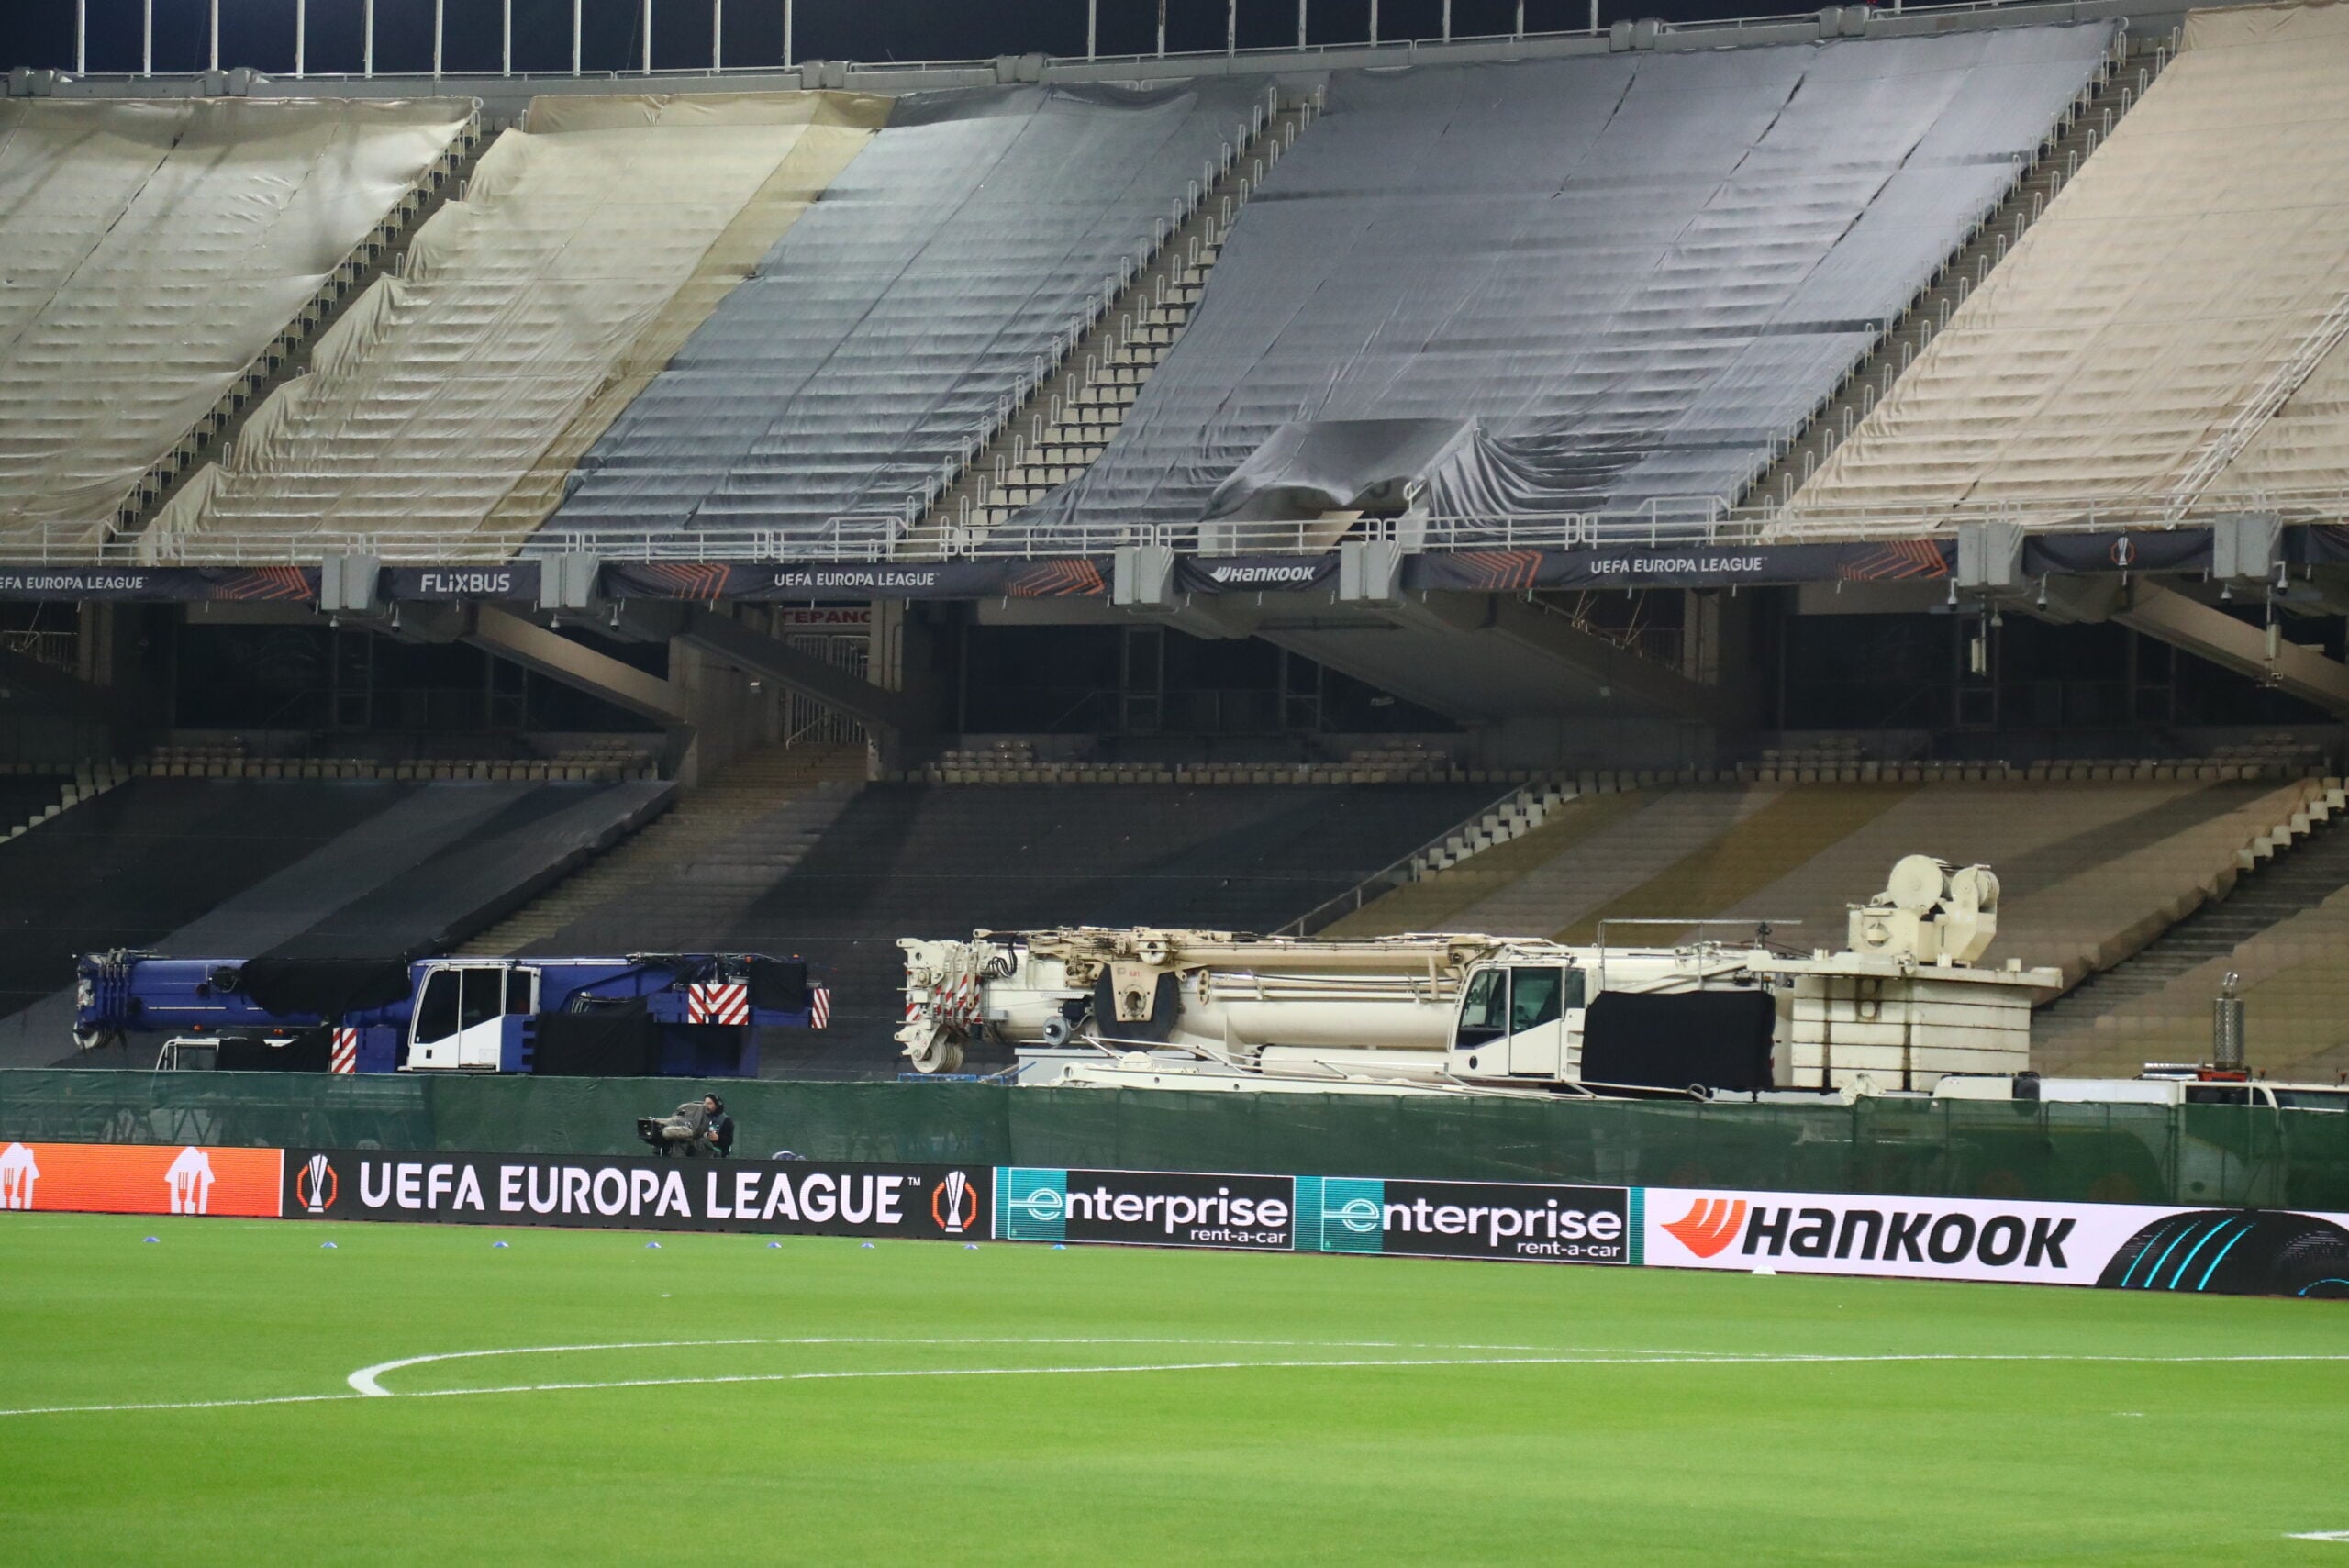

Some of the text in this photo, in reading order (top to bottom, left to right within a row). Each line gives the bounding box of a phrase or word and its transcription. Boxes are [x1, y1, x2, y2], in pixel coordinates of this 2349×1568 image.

[1591, 560, 1630, 574] UEFA
[1633, 558, 1697, 573] EUROPA
[26, 576, 83, 590] EUROPA
[774, 573, 813, 586] UEFA
[816, 573, 874, 586] EUROPA
[360, 1162, 485, 1210] UEFA
[500, 1166, 692, 1218] EUROPA
[1010, 1186, 1288, 1234] enterprise
[1324, 1198, 1622, 1247] enterprise
[1190, 1229, 1286, 1244] rent-a-car
[1517, 1241, 1620, 1258] rent-a-car
